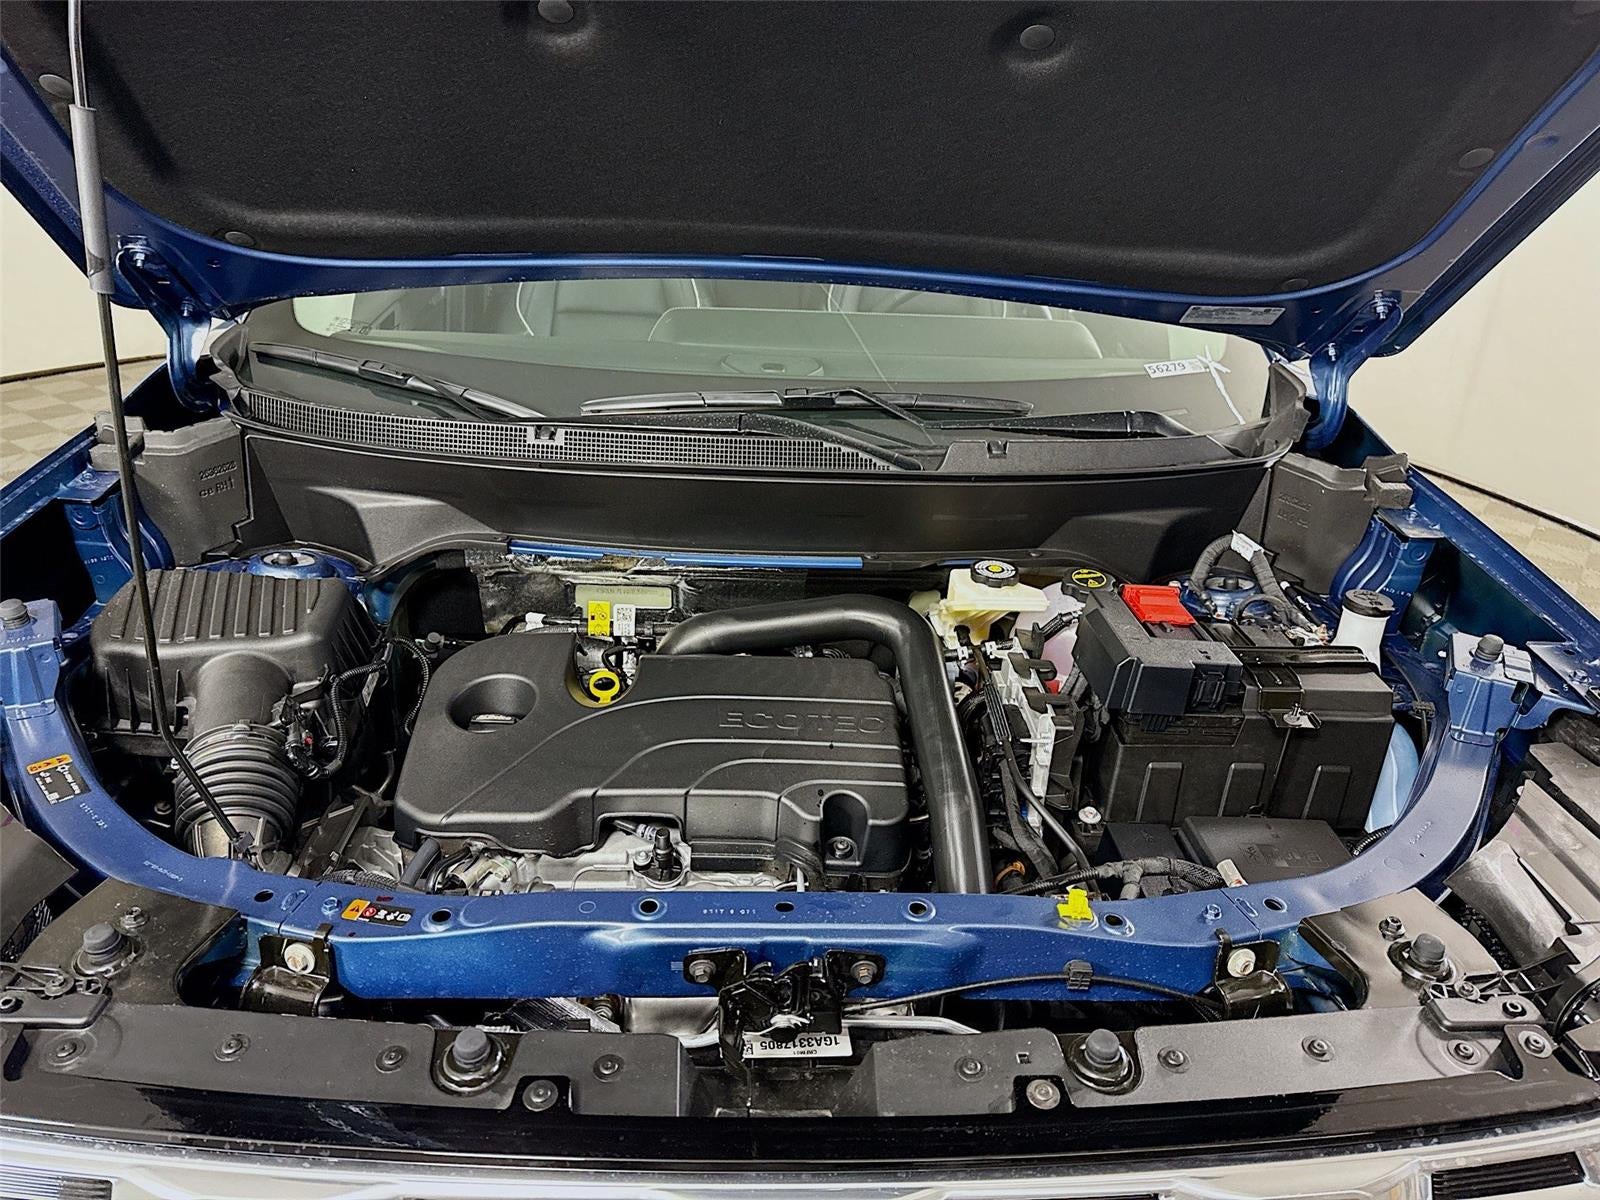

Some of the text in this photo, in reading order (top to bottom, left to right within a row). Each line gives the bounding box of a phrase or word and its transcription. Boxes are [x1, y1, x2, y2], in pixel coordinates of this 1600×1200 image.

[1147, 362, 1186, 374] 56279
[719, 713, 886, 734] ECOTEC
[760, 1035, 841, 1050] 1GA3317805
